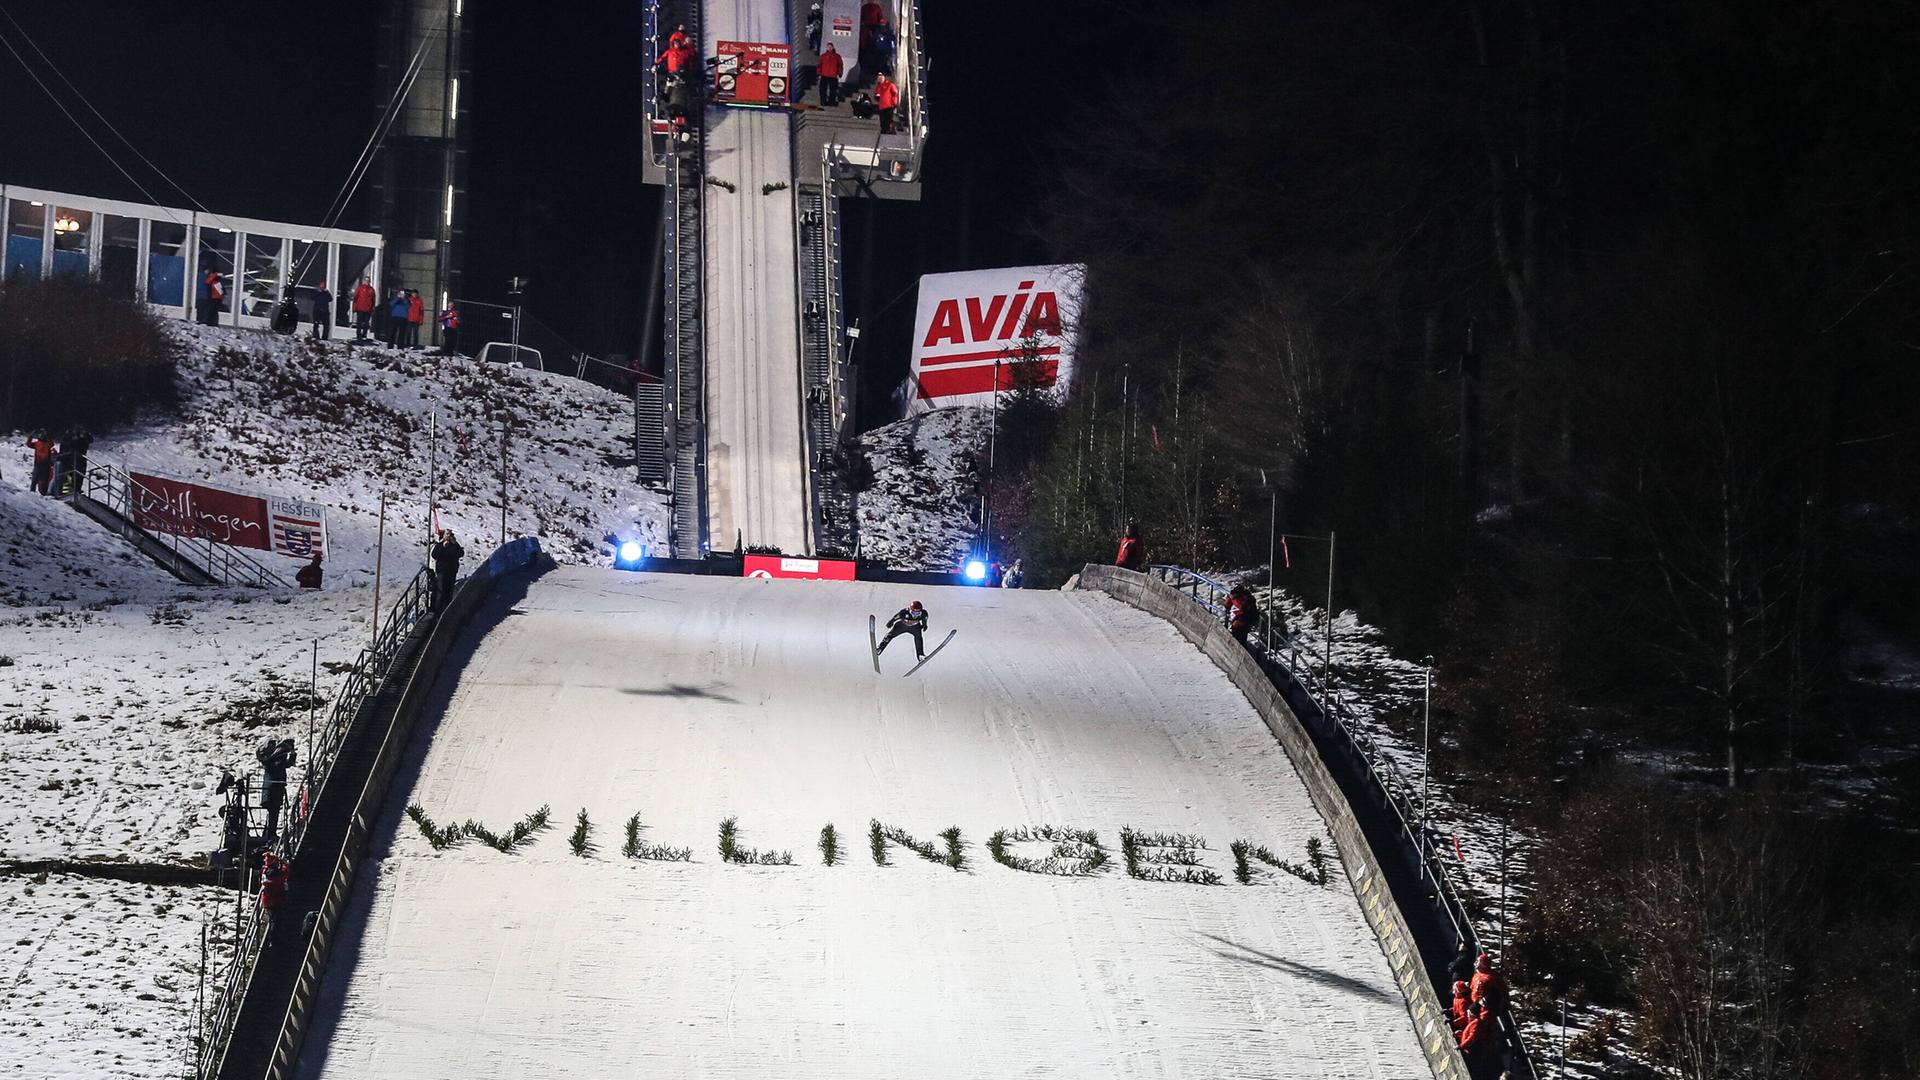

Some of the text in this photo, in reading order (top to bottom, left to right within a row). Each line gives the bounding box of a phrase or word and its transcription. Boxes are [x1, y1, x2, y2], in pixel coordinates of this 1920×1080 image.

[140, 487, 261, 541] Willingen
[271, 501, 321, 518] HESSEN
[405, 801, 1328, 888] WILLINGEN
